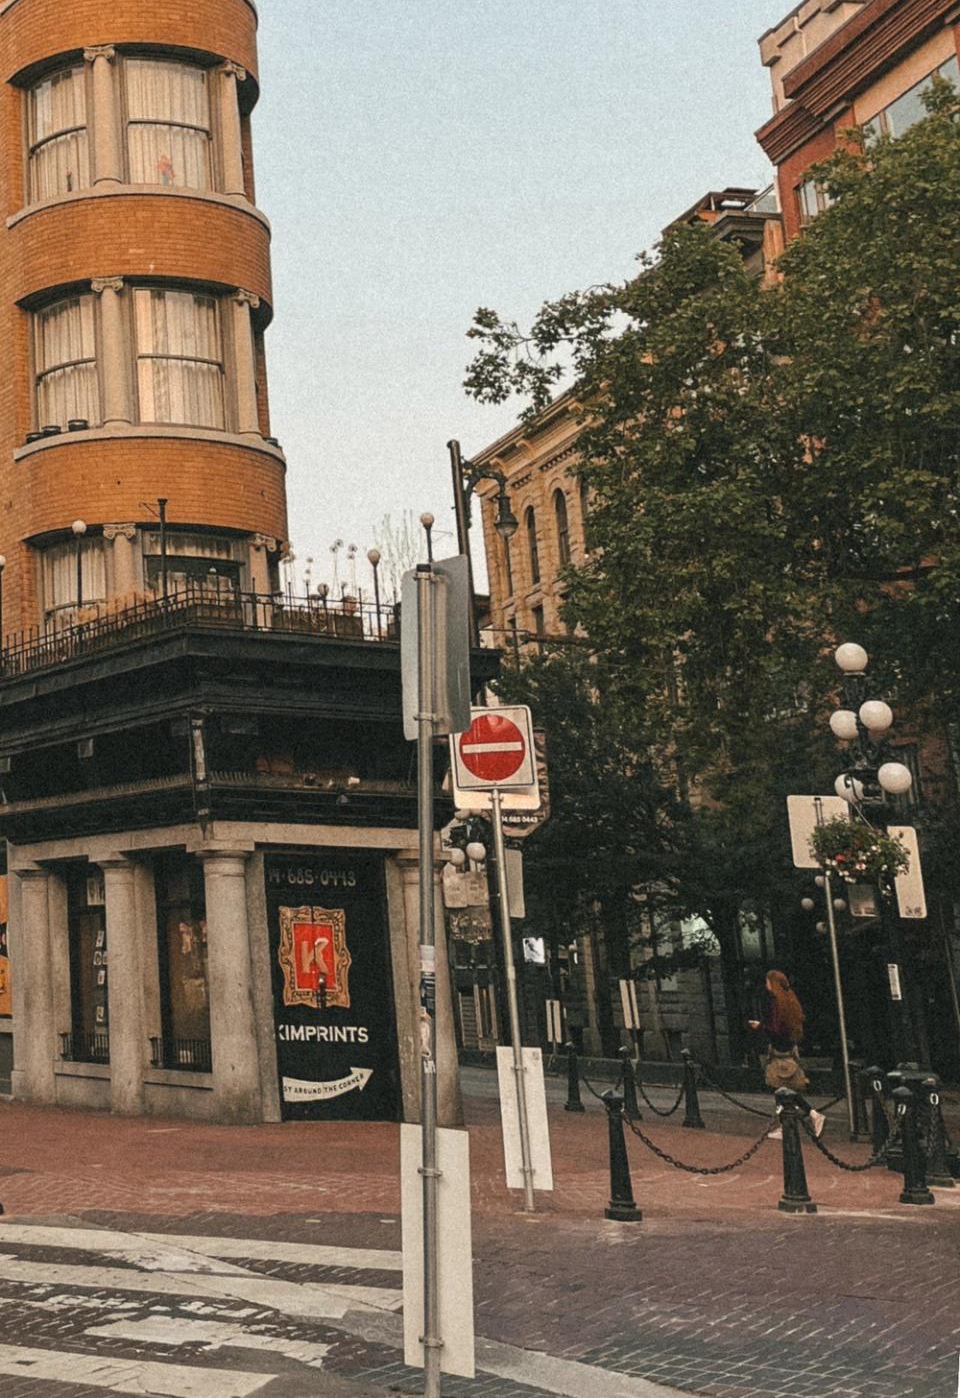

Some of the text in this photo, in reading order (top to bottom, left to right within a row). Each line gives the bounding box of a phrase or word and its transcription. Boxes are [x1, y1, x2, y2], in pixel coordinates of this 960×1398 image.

[294, 1086, 322, 1094] AROUND
[324, 1084, 338, 1093] THE
[338, 1073, 364, 1090] CORNER
